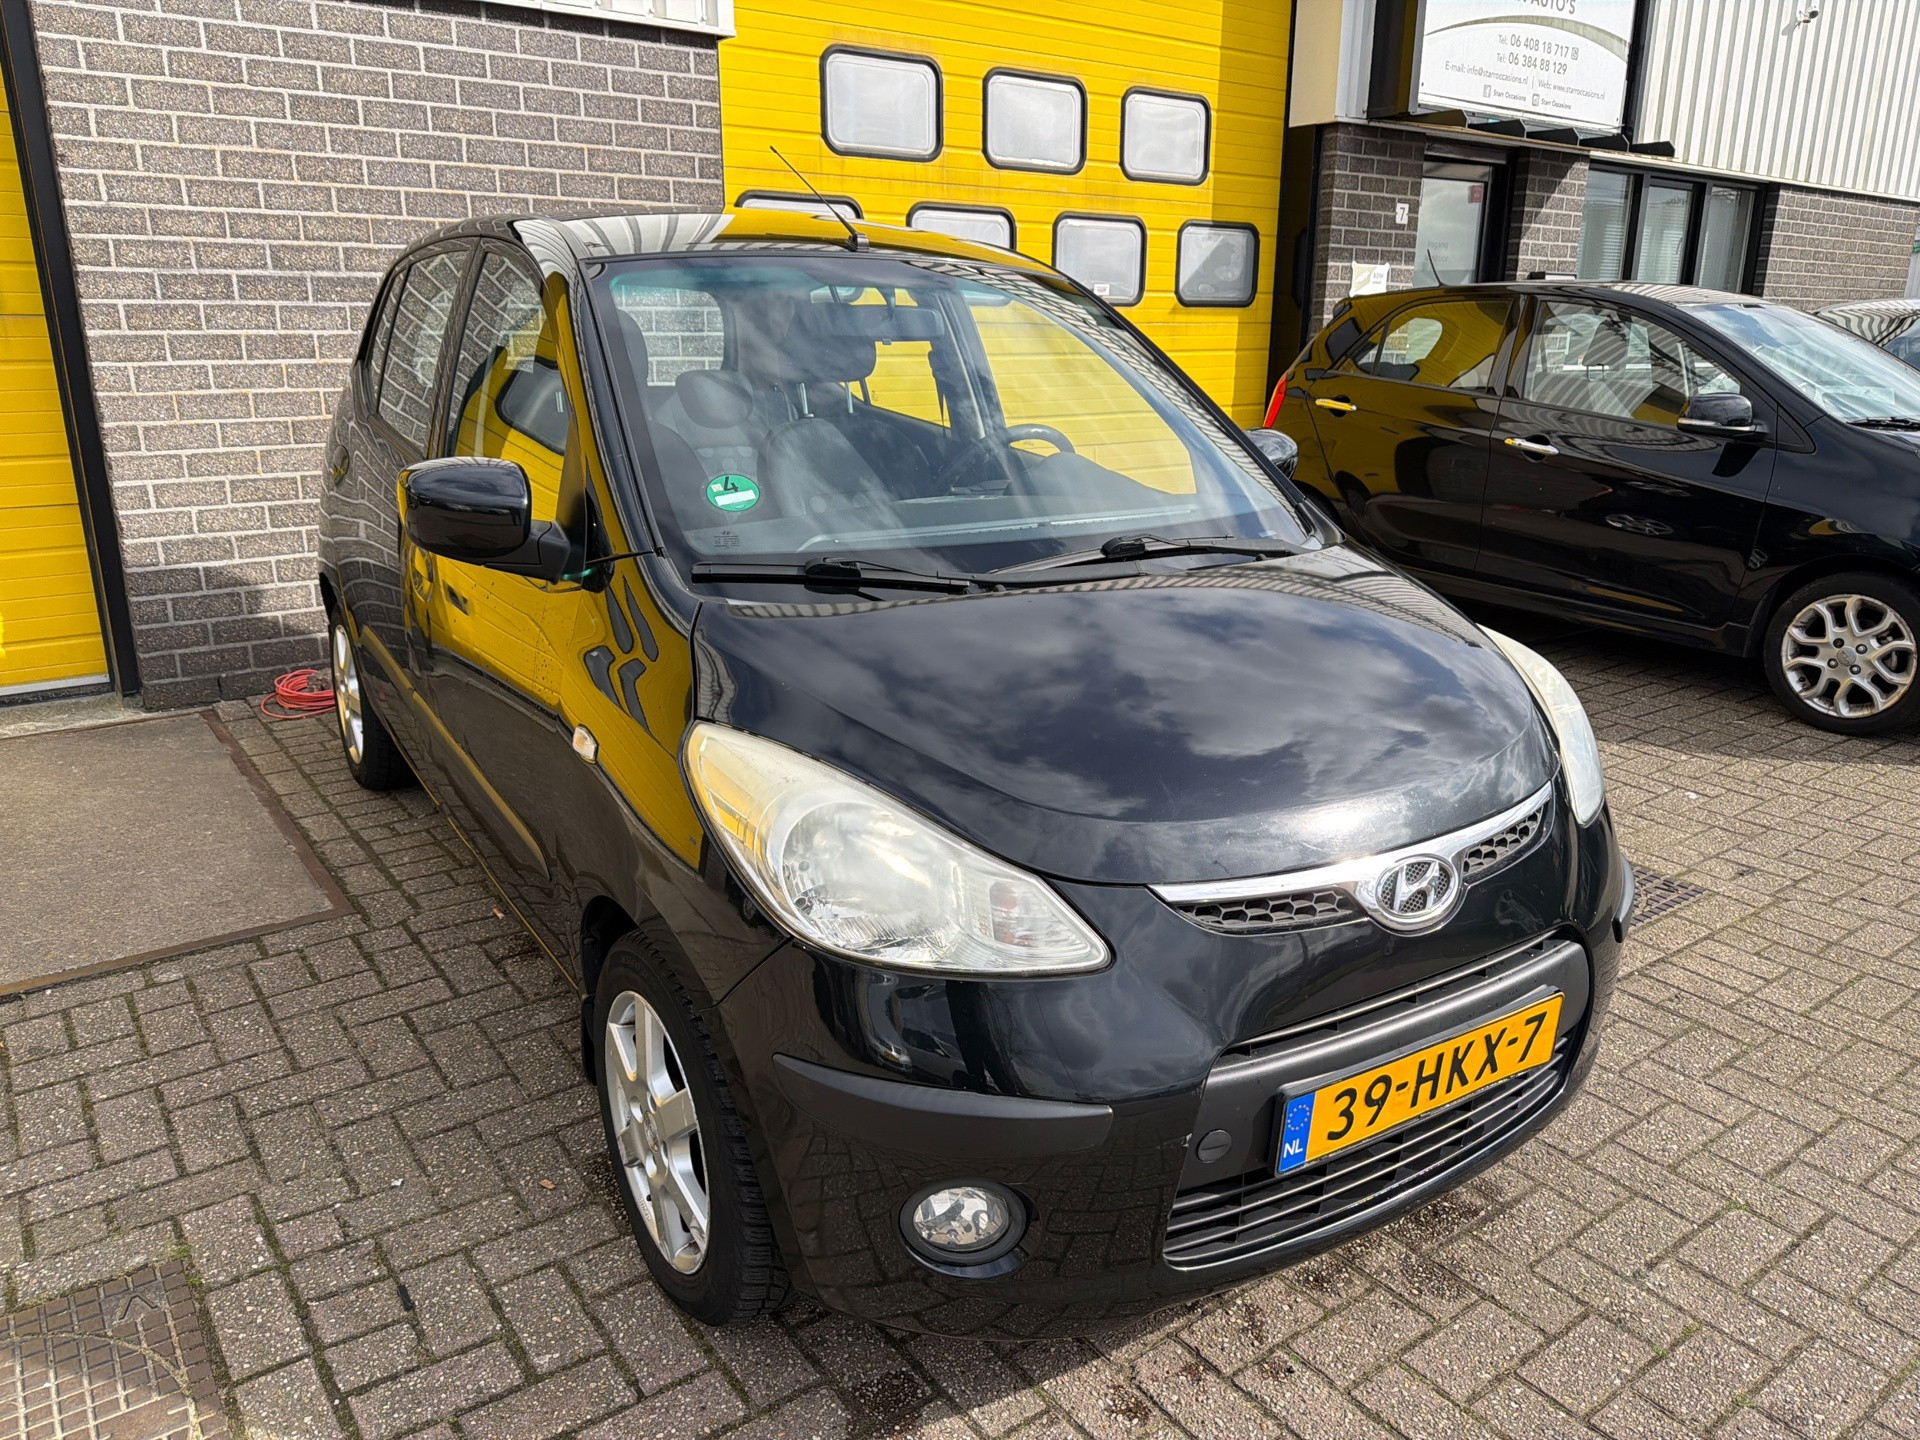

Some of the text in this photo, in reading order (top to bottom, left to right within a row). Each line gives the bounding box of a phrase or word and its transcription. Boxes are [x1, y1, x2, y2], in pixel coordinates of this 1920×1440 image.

[1510, 33, 1522, 48] 06
[1523, 37, 1540, 51] 408
[1542, 41, 1552, 54] 18
[1554, 43, 1569, 58] 717
[1445, 60, 1529, 85] E-mail: info@starroccasions.nl
[1508, 52, 1519, 66] 06
[1521, 54, 1538, 69] 384
[1539, 58, 1550, 72] 88
[1552, 61, 1568, 76] 129
[1538, 79, 1552, 90] Web:
[1399, 206, 1406, 222] 7
[723, 476, 739, 492] 4
[1327, 1011, 1548, 1141] 39-HKX-7
[1283, 1139, 1304, 1158] NL
